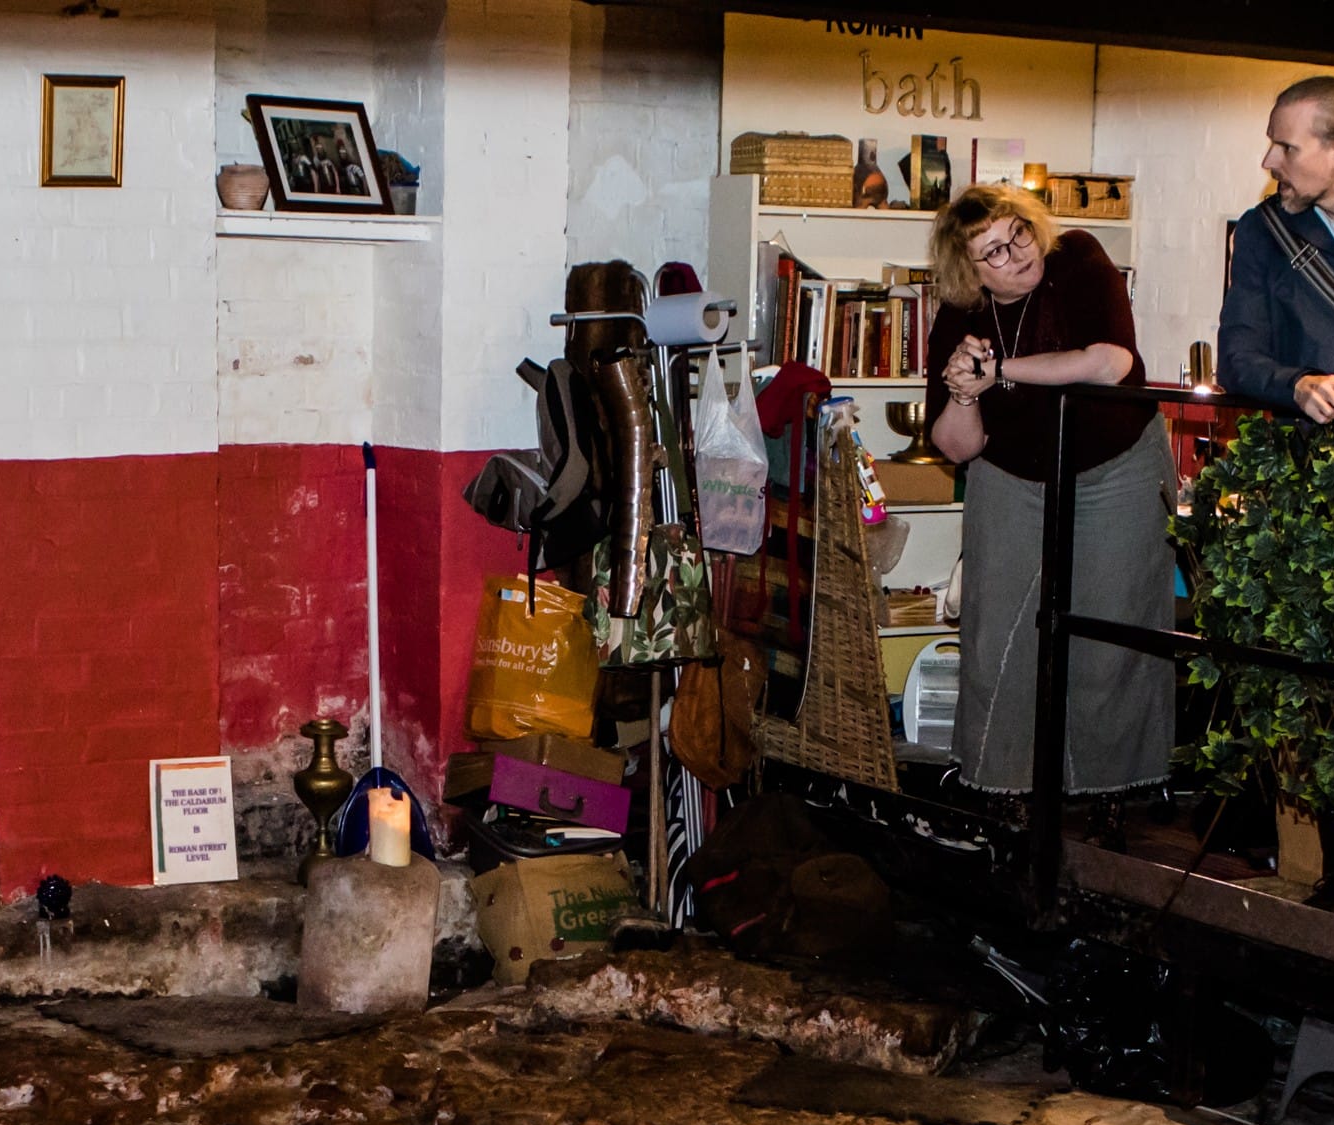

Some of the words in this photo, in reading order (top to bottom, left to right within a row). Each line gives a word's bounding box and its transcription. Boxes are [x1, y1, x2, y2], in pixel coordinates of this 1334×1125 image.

[859, 48, 983, 121] bath
[499, 659, 511, 668] for
[513, 661, 524, 671] all
[171, 789, 186, 797] THE
[188, 788, 207, 796] BASE
[165, 799, 179, 807] THE
[180, 797, 226, 805] CALDARIUM
[183, 807, 208, 815] FLOOR
[169, 845, 197, 853] ROMAN
[199, 843, 227, 851] STREET
[186, 853, 210, 862] LEVEL
